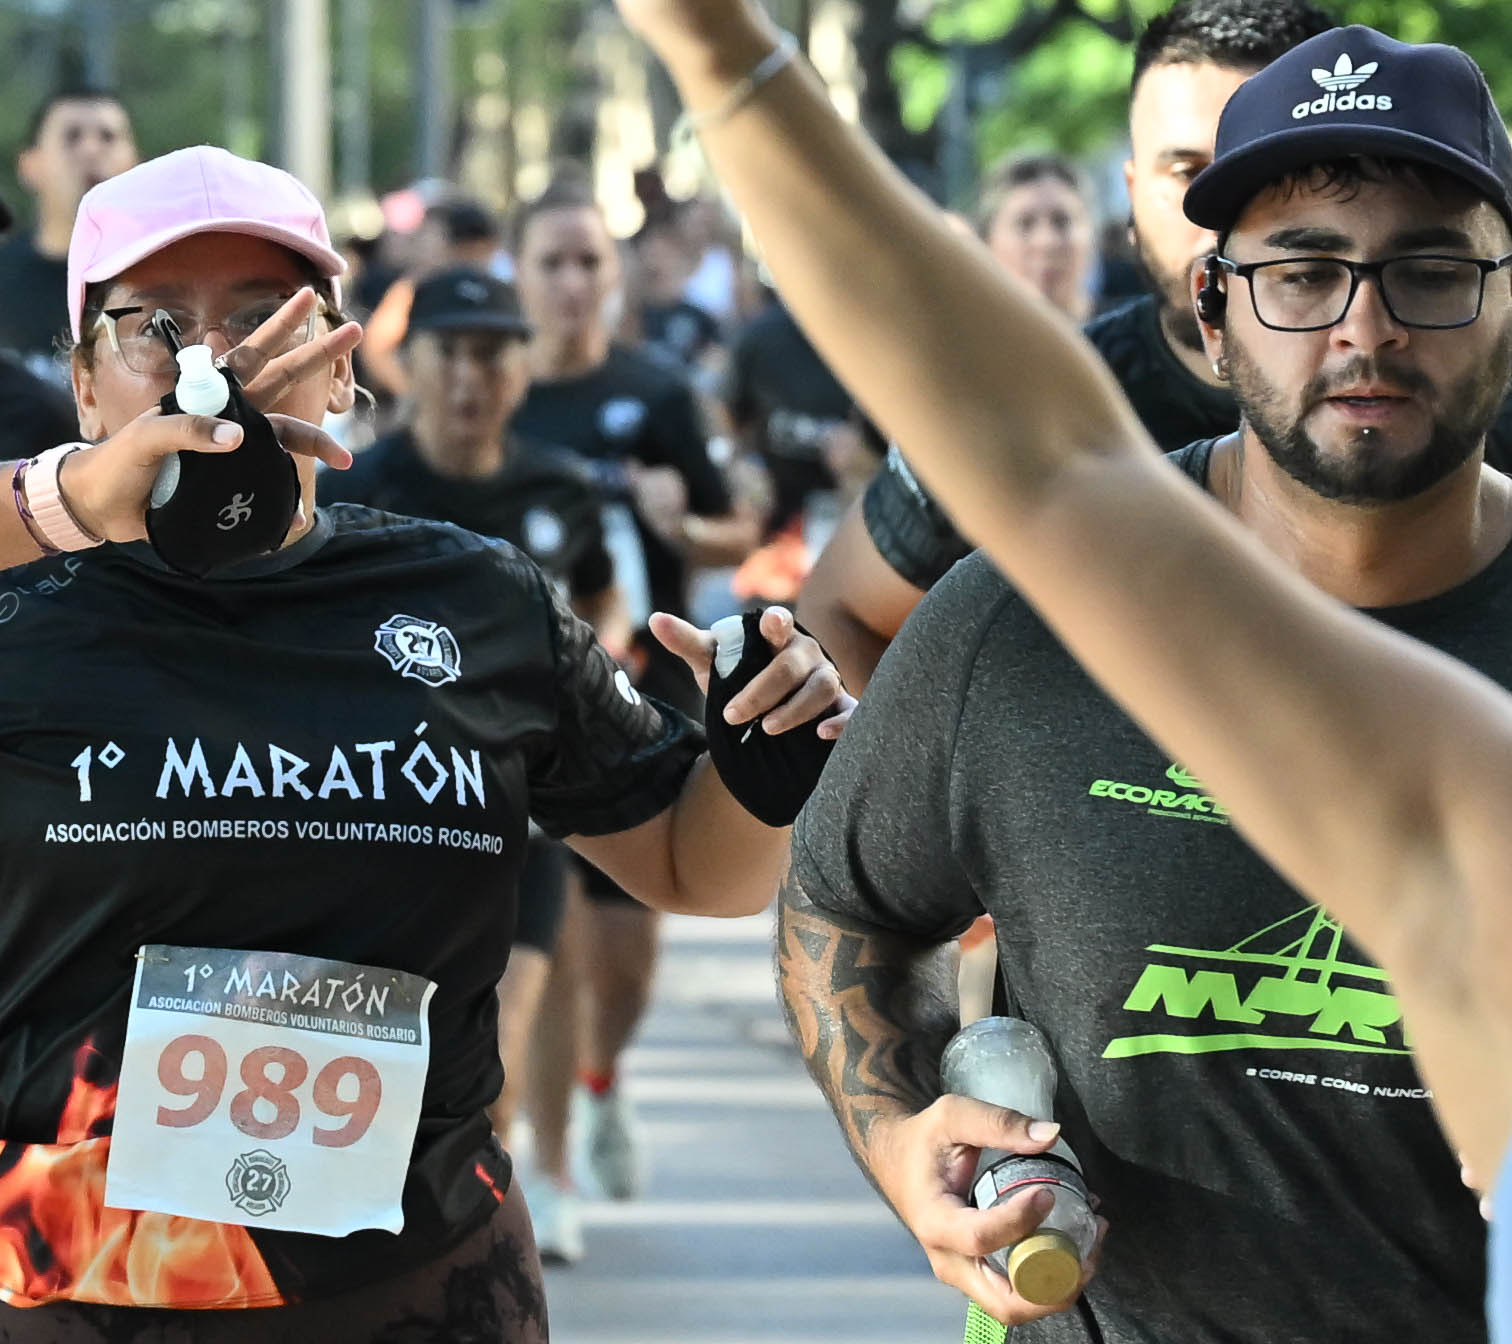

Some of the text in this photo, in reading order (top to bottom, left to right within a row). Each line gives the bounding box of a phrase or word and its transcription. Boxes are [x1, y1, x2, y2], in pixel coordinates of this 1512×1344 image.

[1292, 91, 1392, 119] adidas
[402, 630, 435, 657] 27
[70, 720, 488, 810] 1° MARATÓN
[44, 816, 504, 856] ASOCIACIÓN BOMBEROS VOLUNTARIOS ROSARIO
[183, 963, 390, 1017] 1° MARATÓN
[148, 994, 417, 1043] ASOCIACIÓN BOMBEROS VOLUNTARIOS ROSARIO
[156, 1033, 383, 1149] 989
[1259, 1067, 1317, 1085] CORRE
[1321, 1076, 1370, 1095] COMO
[246, 1168, 274, 1193] 27
